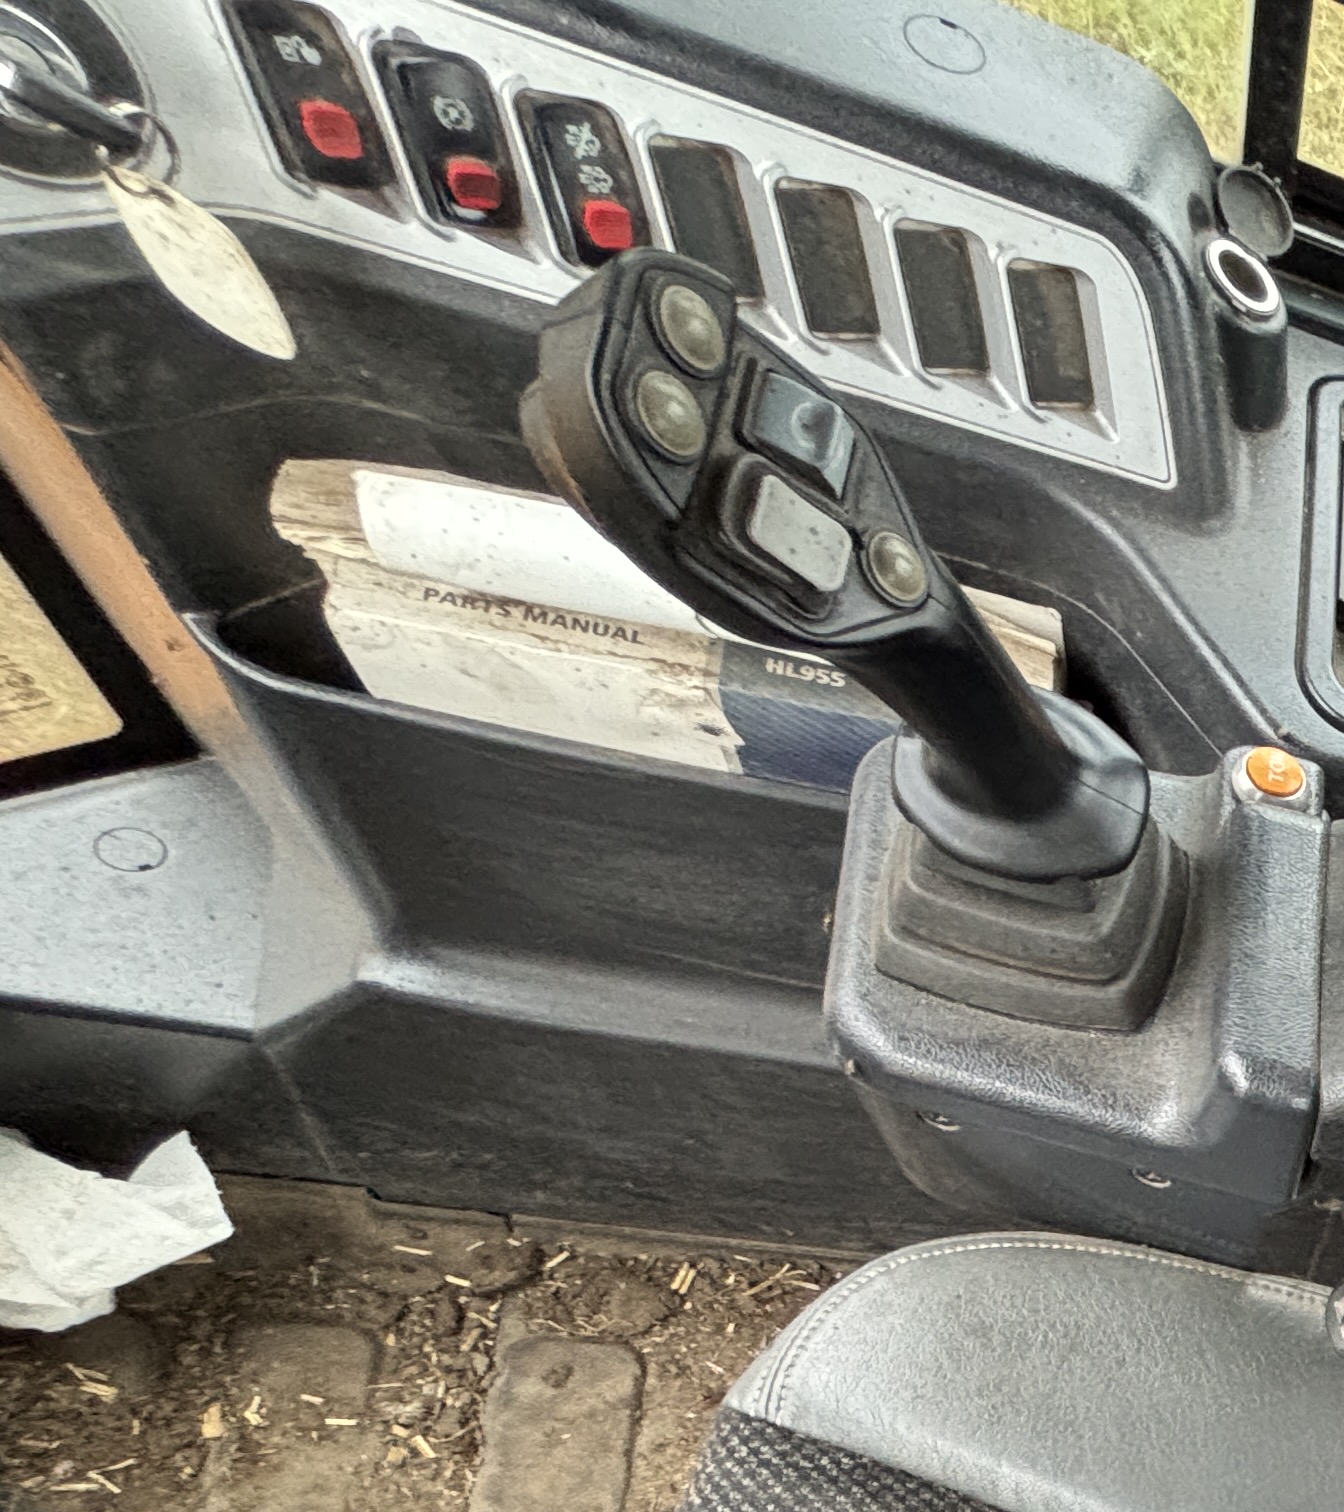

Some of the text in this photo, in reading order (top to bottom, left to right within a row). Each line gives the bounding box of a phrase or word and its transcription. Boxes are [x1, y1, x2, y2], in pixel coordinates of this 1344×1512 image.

[423, 587, 646, 645] PARTS MANUAL
[764, 656, 847, 688] HL955
